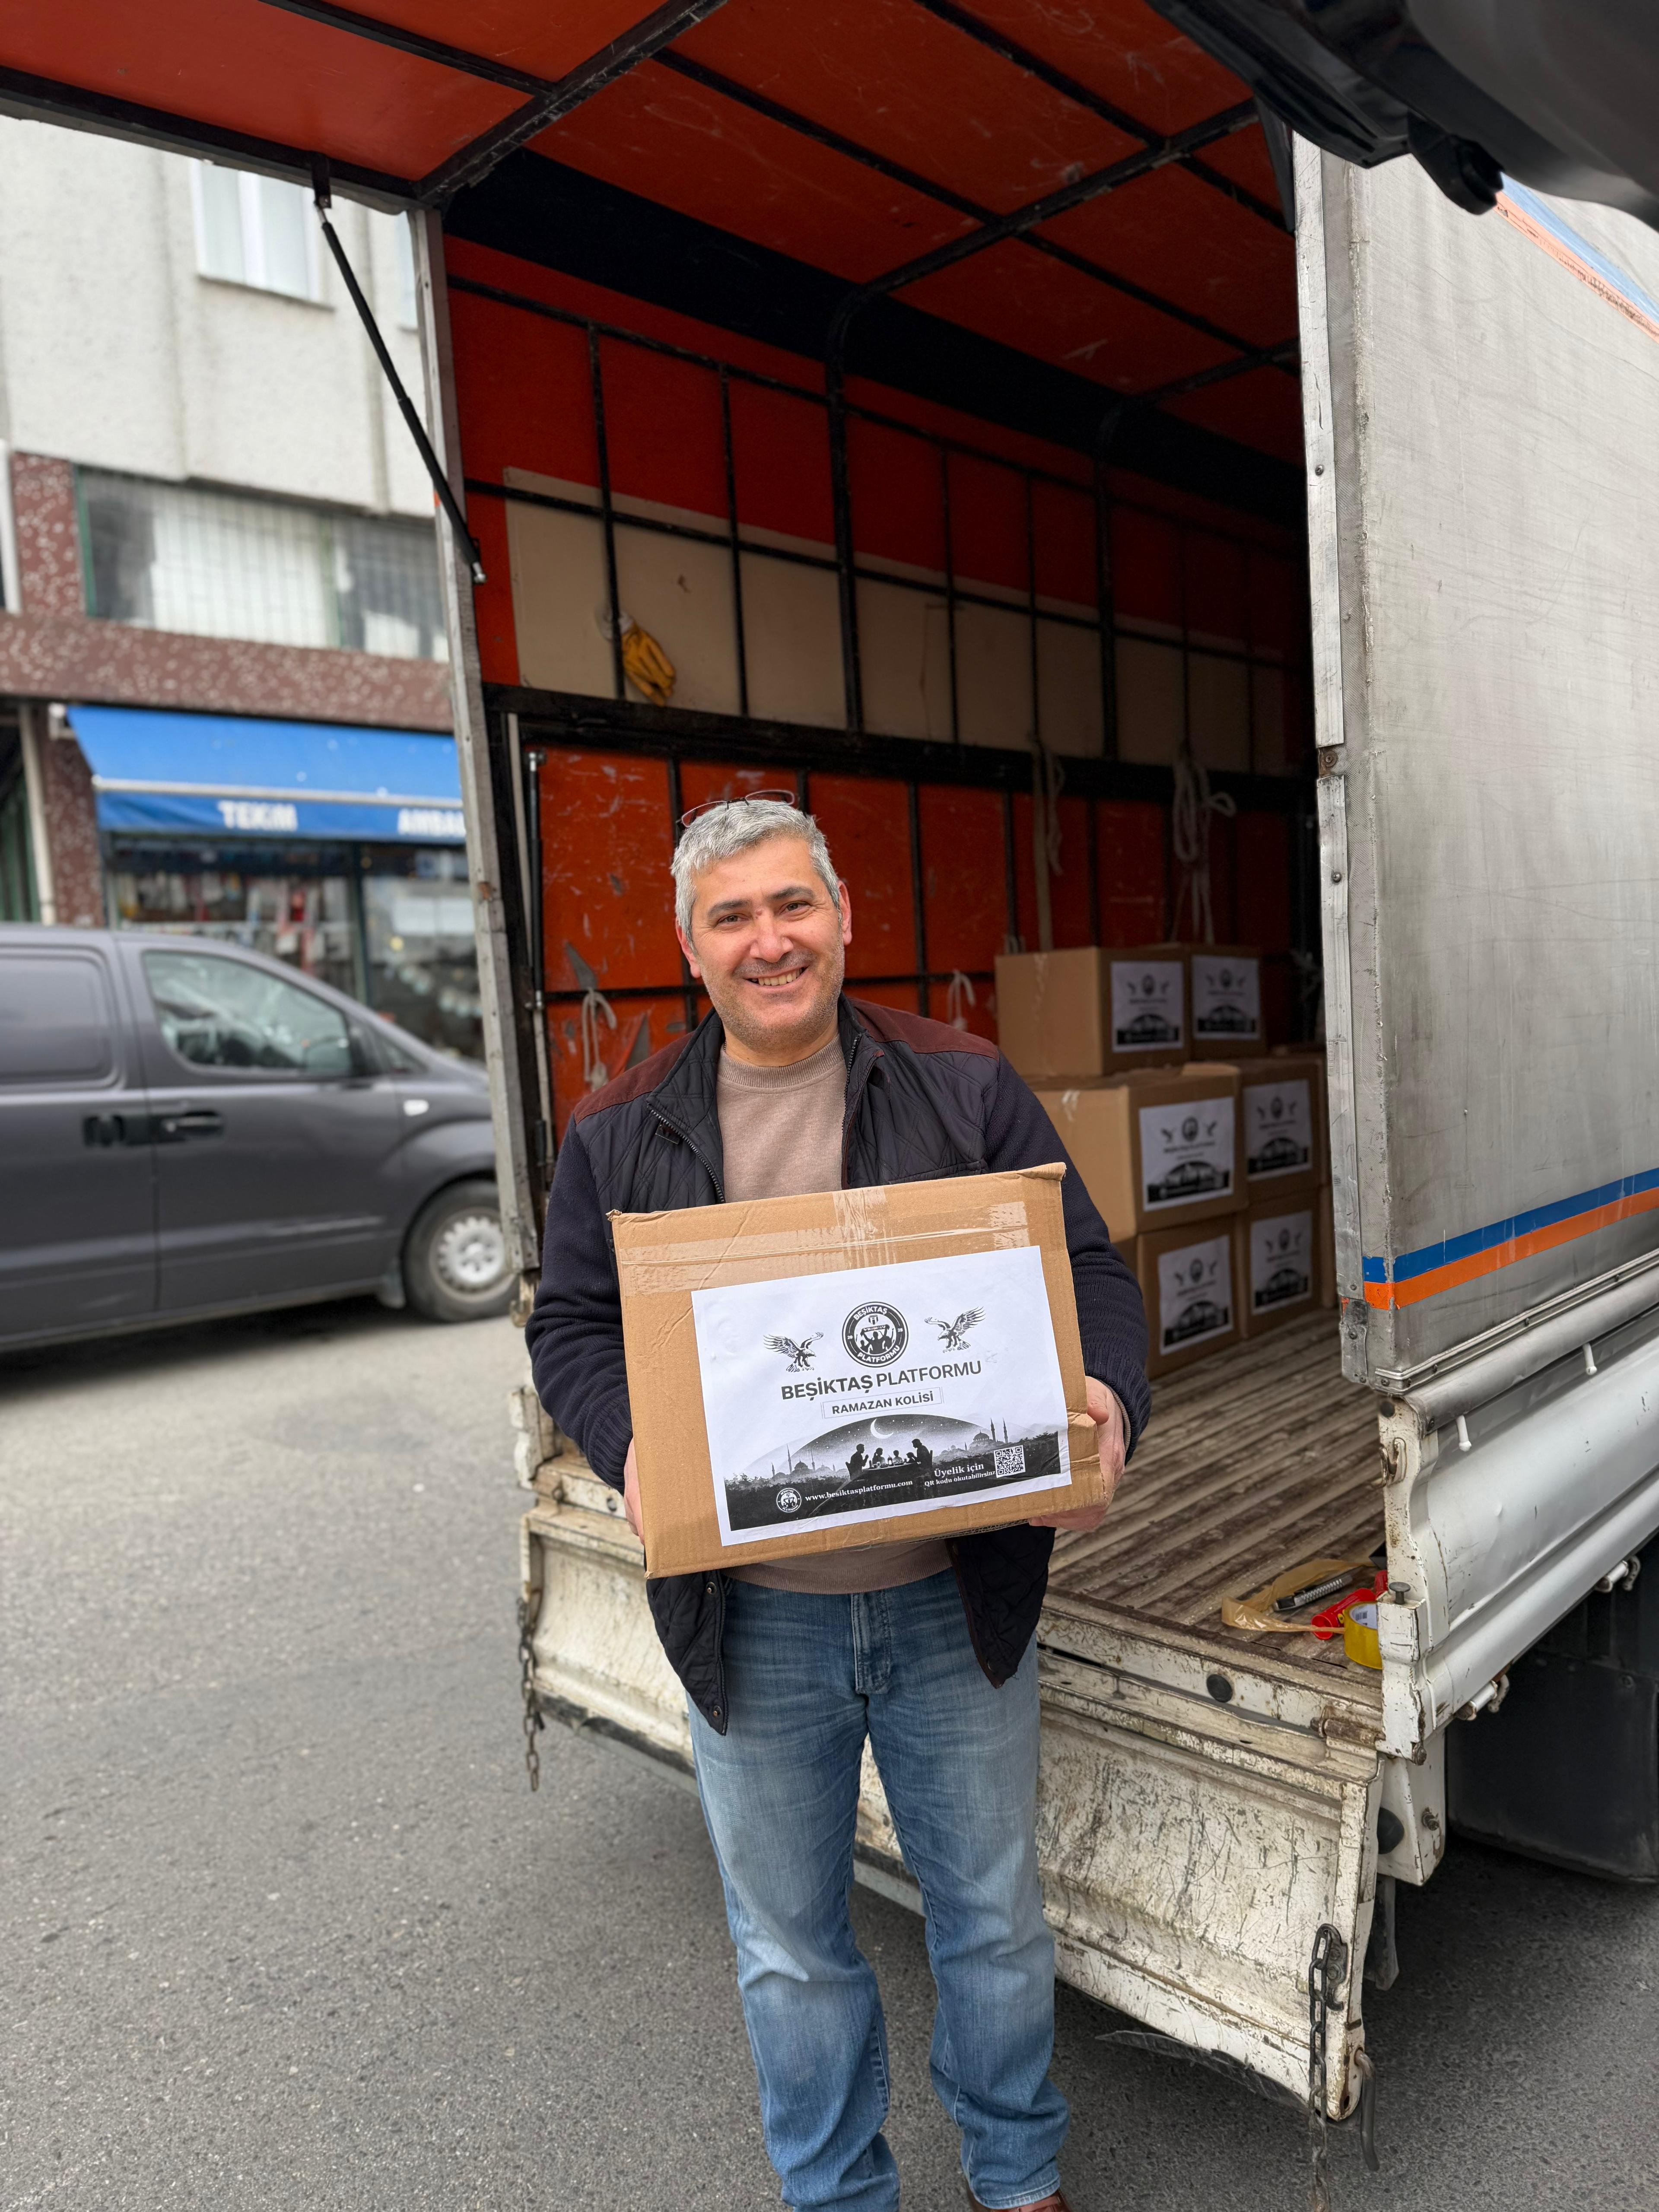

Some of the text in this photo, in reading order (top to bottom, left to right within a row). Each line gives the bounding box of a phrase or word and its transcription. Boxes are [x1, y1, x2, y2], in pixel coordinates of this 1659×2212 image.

[853, 1306, 888, 1321] BEŞİKTAŞ
[857, 1344, 900, 1363] PLATFORMU
[781, 1360, 982, 1401] BEŞİKTAŞ PLATFORMU
[831, 1391, 934, 1414] RAMAZAN KOLİSİ
[934, 1463, 985, 1478] Üyelik için
[804, 1480, 913, 1501] www.besiktasplatformu.com
